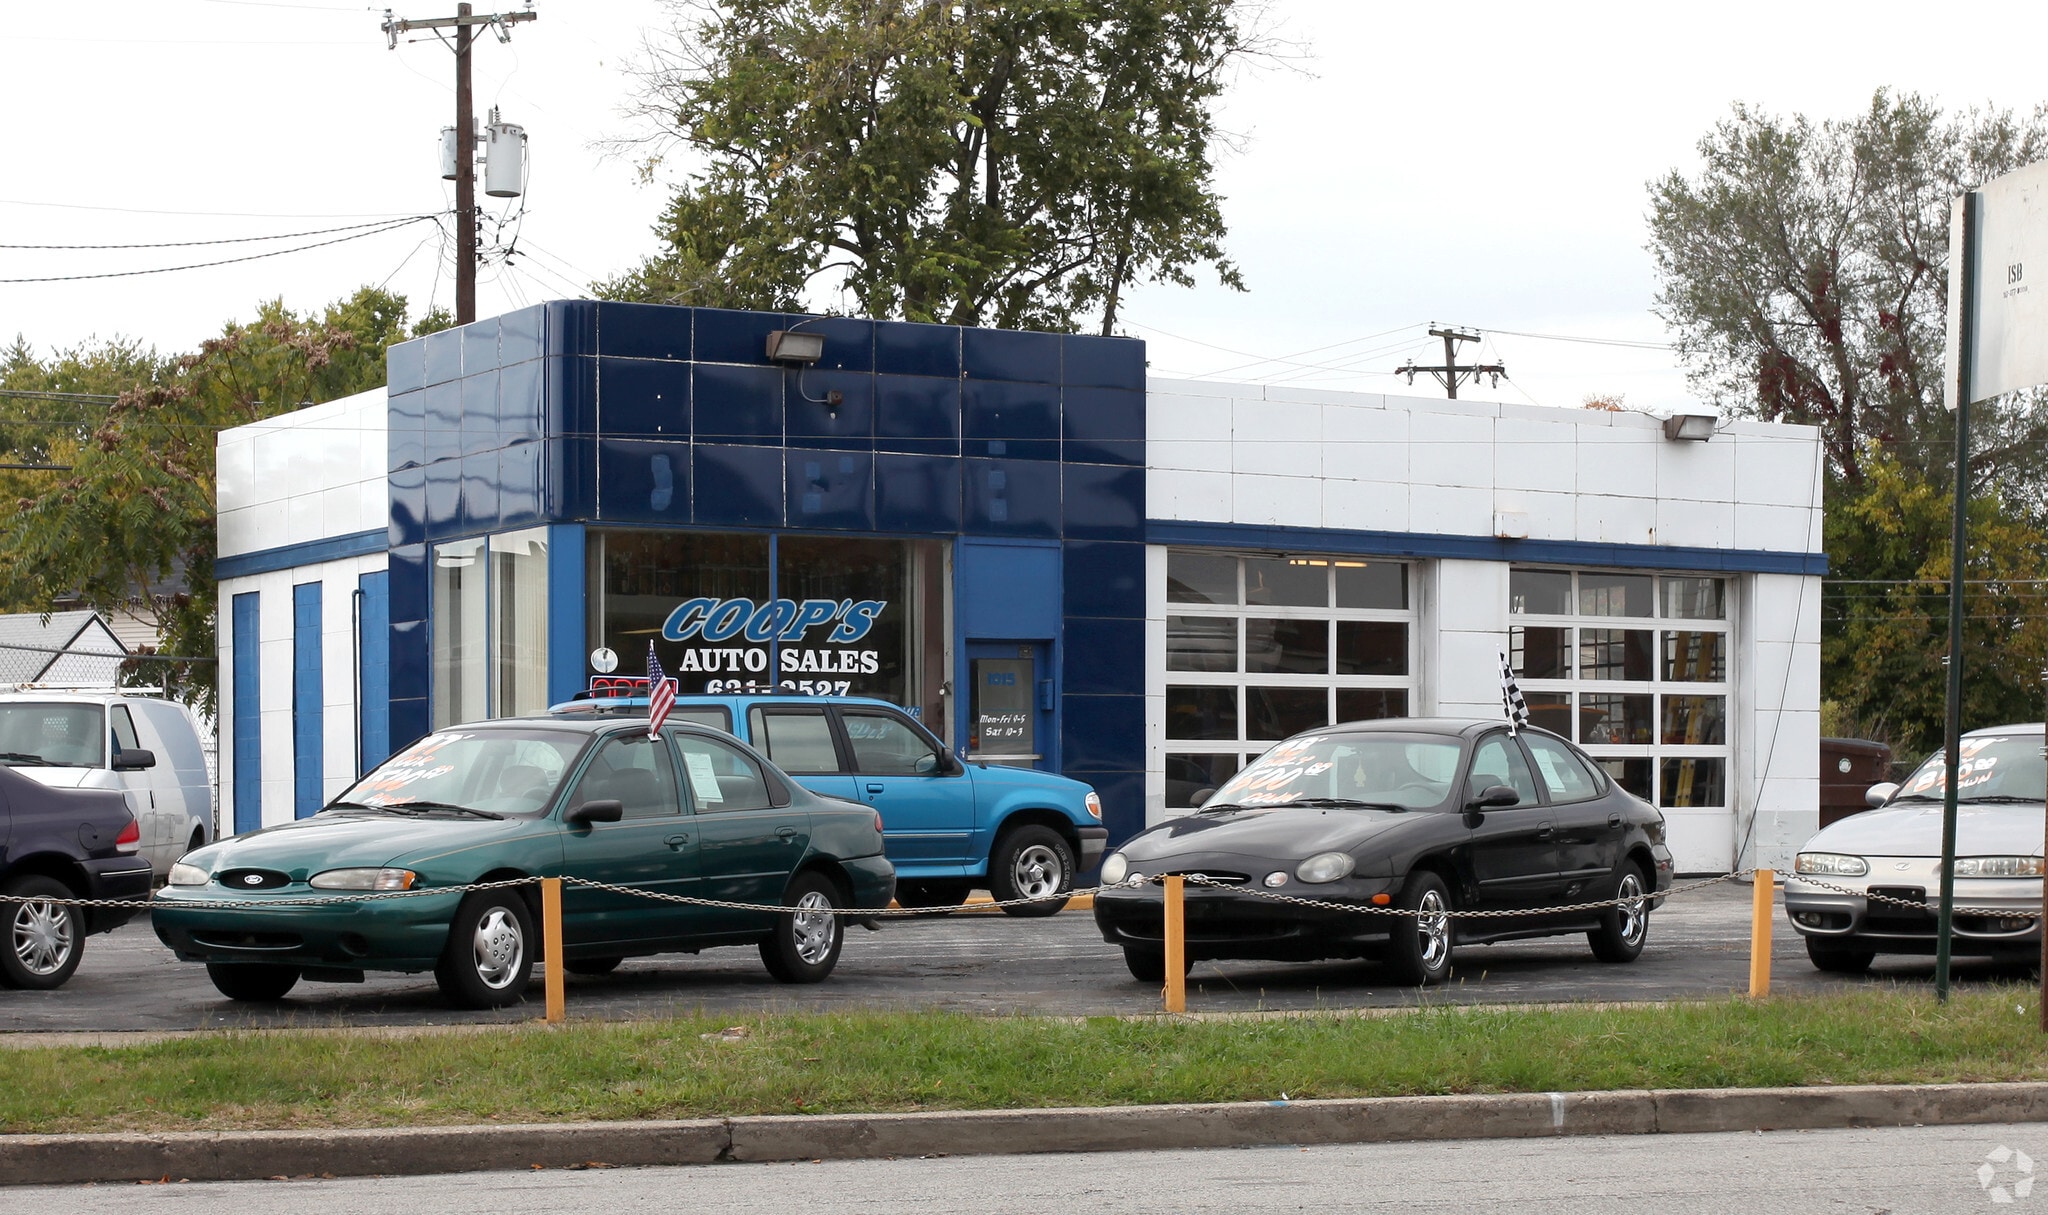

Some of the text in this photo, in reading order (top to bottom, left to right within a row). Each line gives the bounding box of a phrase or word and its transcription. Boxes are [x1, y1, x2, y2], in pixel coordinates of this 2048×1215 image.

[661, 597, 888, 643] COOP'S
[679, 647, 879, 674] AUTO SALES
[986, 727, 1002, 737] Sat
